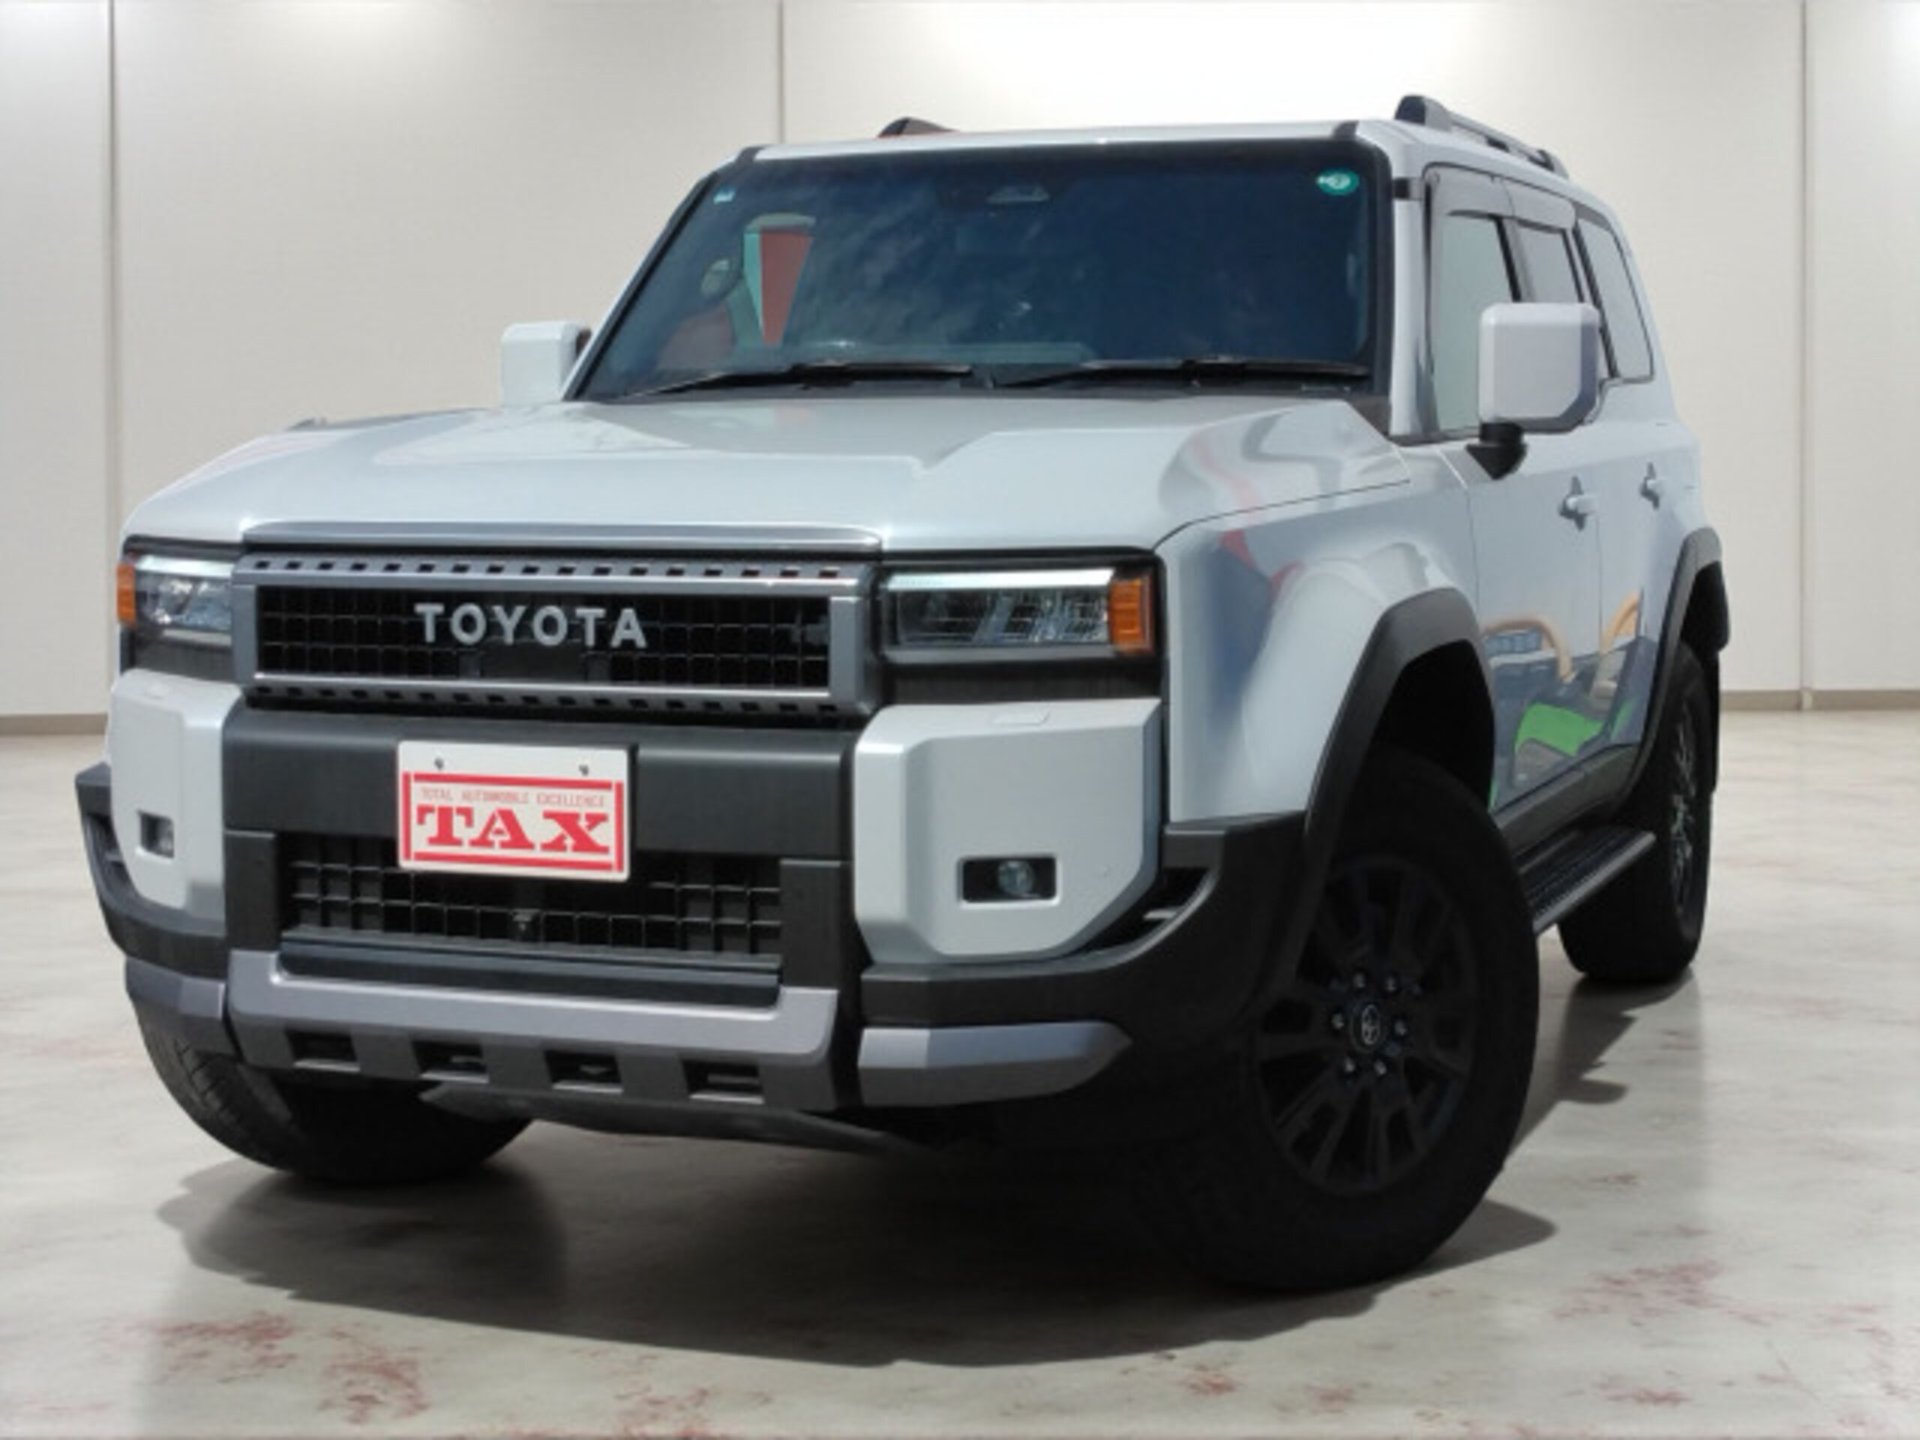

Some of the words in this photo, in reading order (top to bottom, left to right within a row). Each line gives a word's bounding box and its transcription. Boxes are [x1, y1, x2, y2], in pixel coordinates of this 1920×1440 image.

[414, 603, 647, 649] TOYOTA
[420, 786, 454, 800] TOTAL
[461, 790, 529, 804] AUTOMOBILE
[536, 793, 606, 808] EXCELLENCE
[416, 804, 609, 854] TAX
